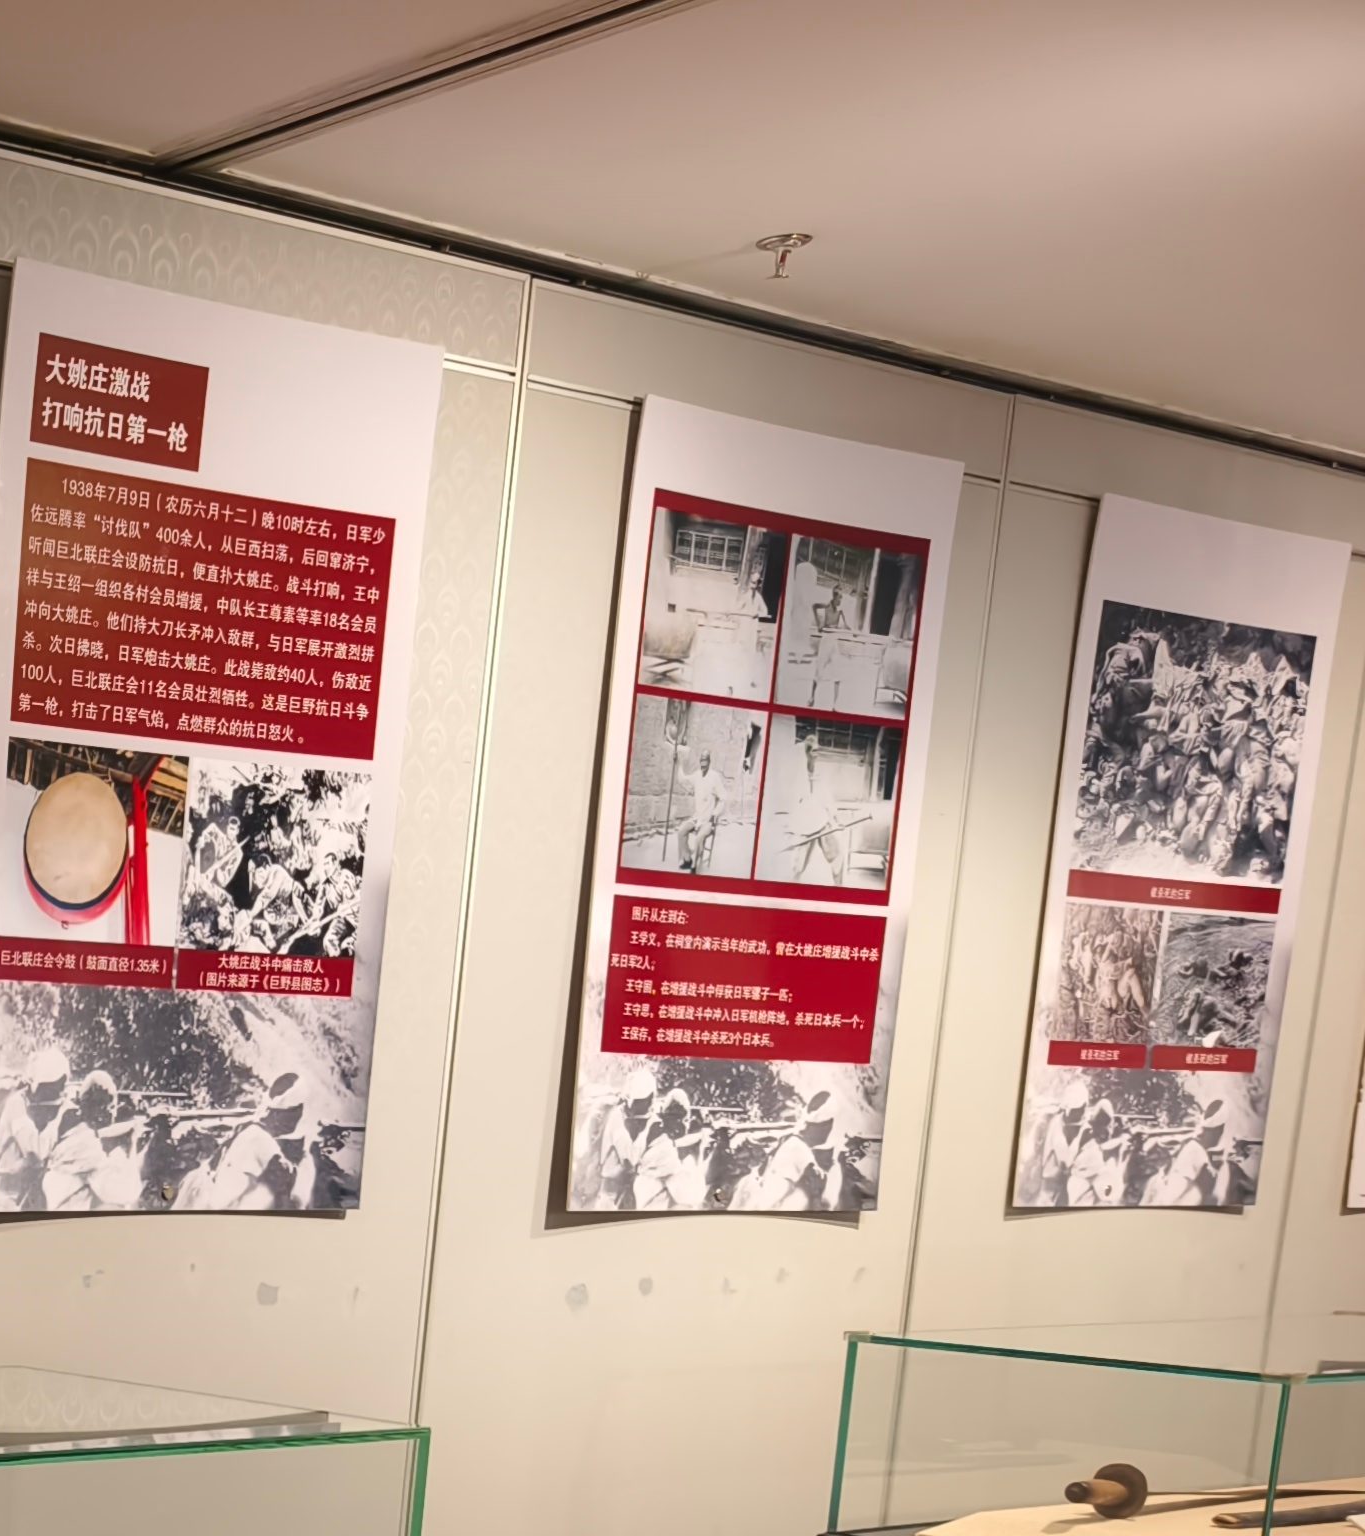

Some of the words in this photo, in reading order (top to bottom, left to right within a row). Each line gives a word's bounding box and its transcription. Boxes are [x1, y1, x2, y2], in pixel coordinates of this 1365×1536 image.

[45, 353, 152, 403] 大姚庄激战
[41, 397, 190, 454] 打响抗日第一枪
[28, 535, 381, 605] 听闻巨北联庄会设防抗日，便直扑大姚庄。战斗打响，王中
[23, 599, 375, 663] 冲向大姚庄。他们持大刀长矛冲入敌群，与日军展开激烈拼
[20, 664, 370, 721] 100人，巨北联庄会11名会员壮烈牺牲。这是巨野抗日斗争
[218, 954, 324, 974] 大姚庄战斗中痛击敌人
